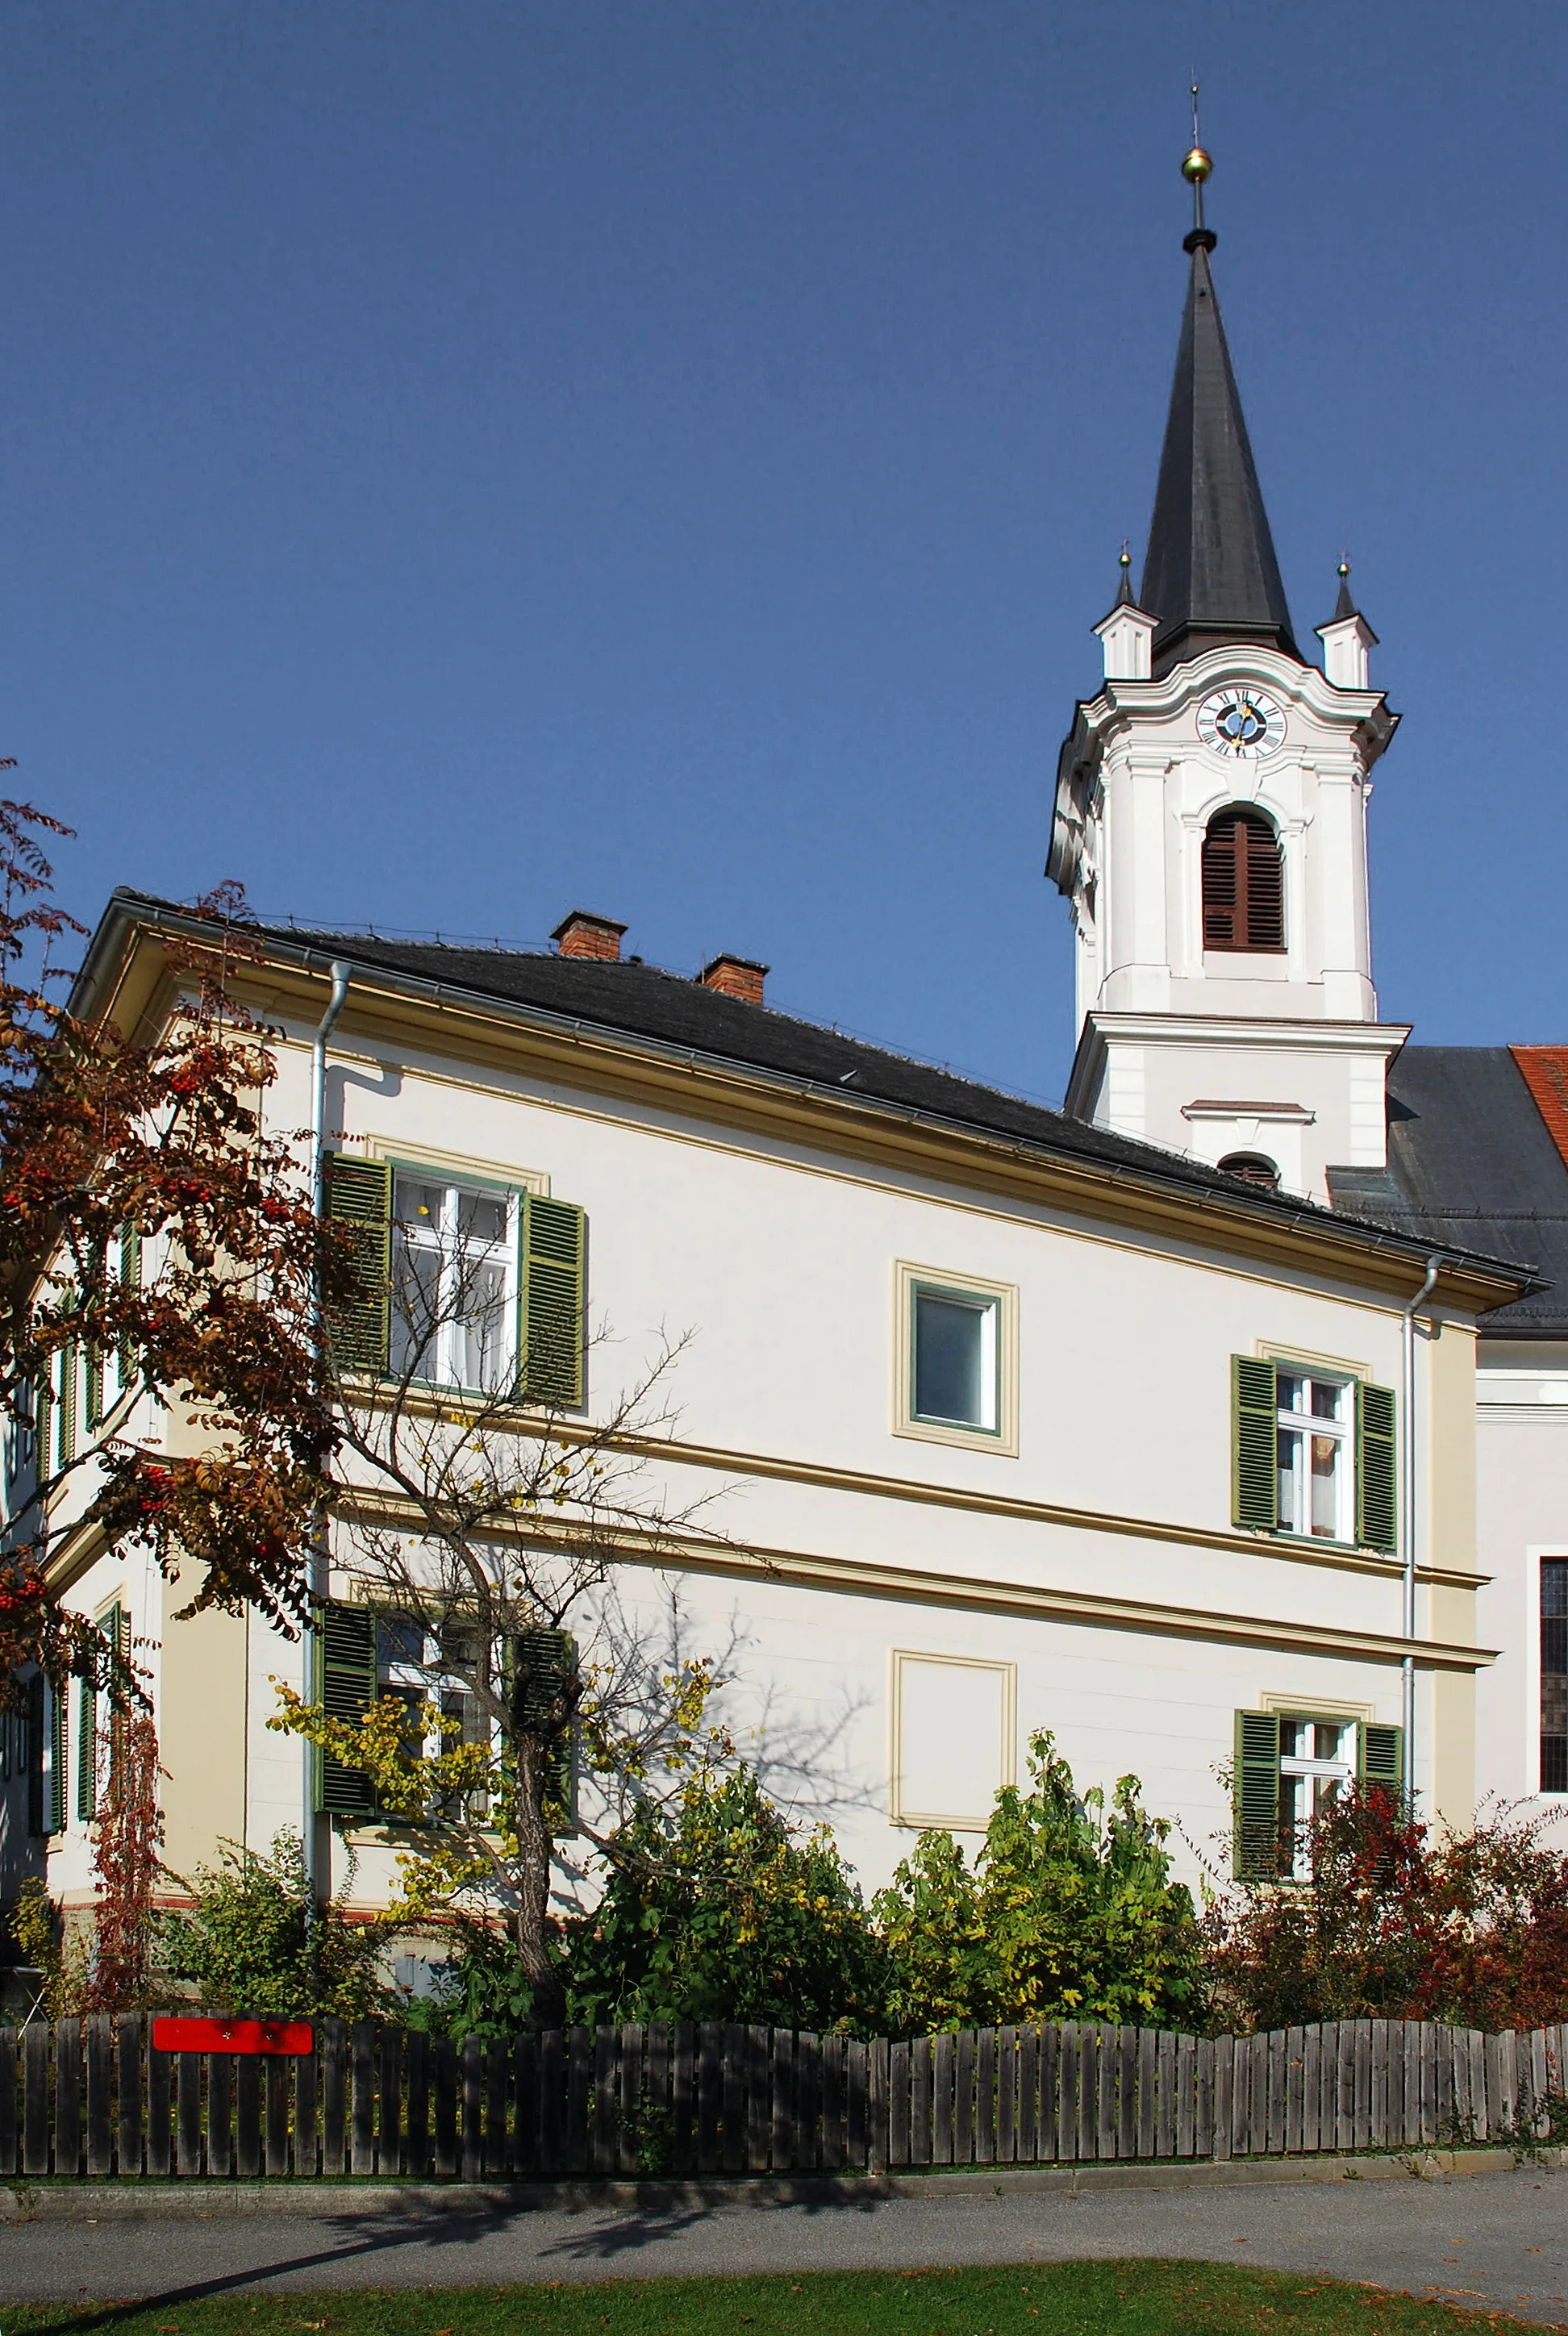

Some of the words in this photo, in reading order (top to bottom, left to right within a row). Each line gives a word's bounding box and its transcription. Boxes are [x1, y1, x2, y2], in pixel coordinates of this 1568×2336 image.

[1217, 692, 1231, 704] XI
[1263, 707, 1279, 717] II
[1267, 722, 1283, 732] III
